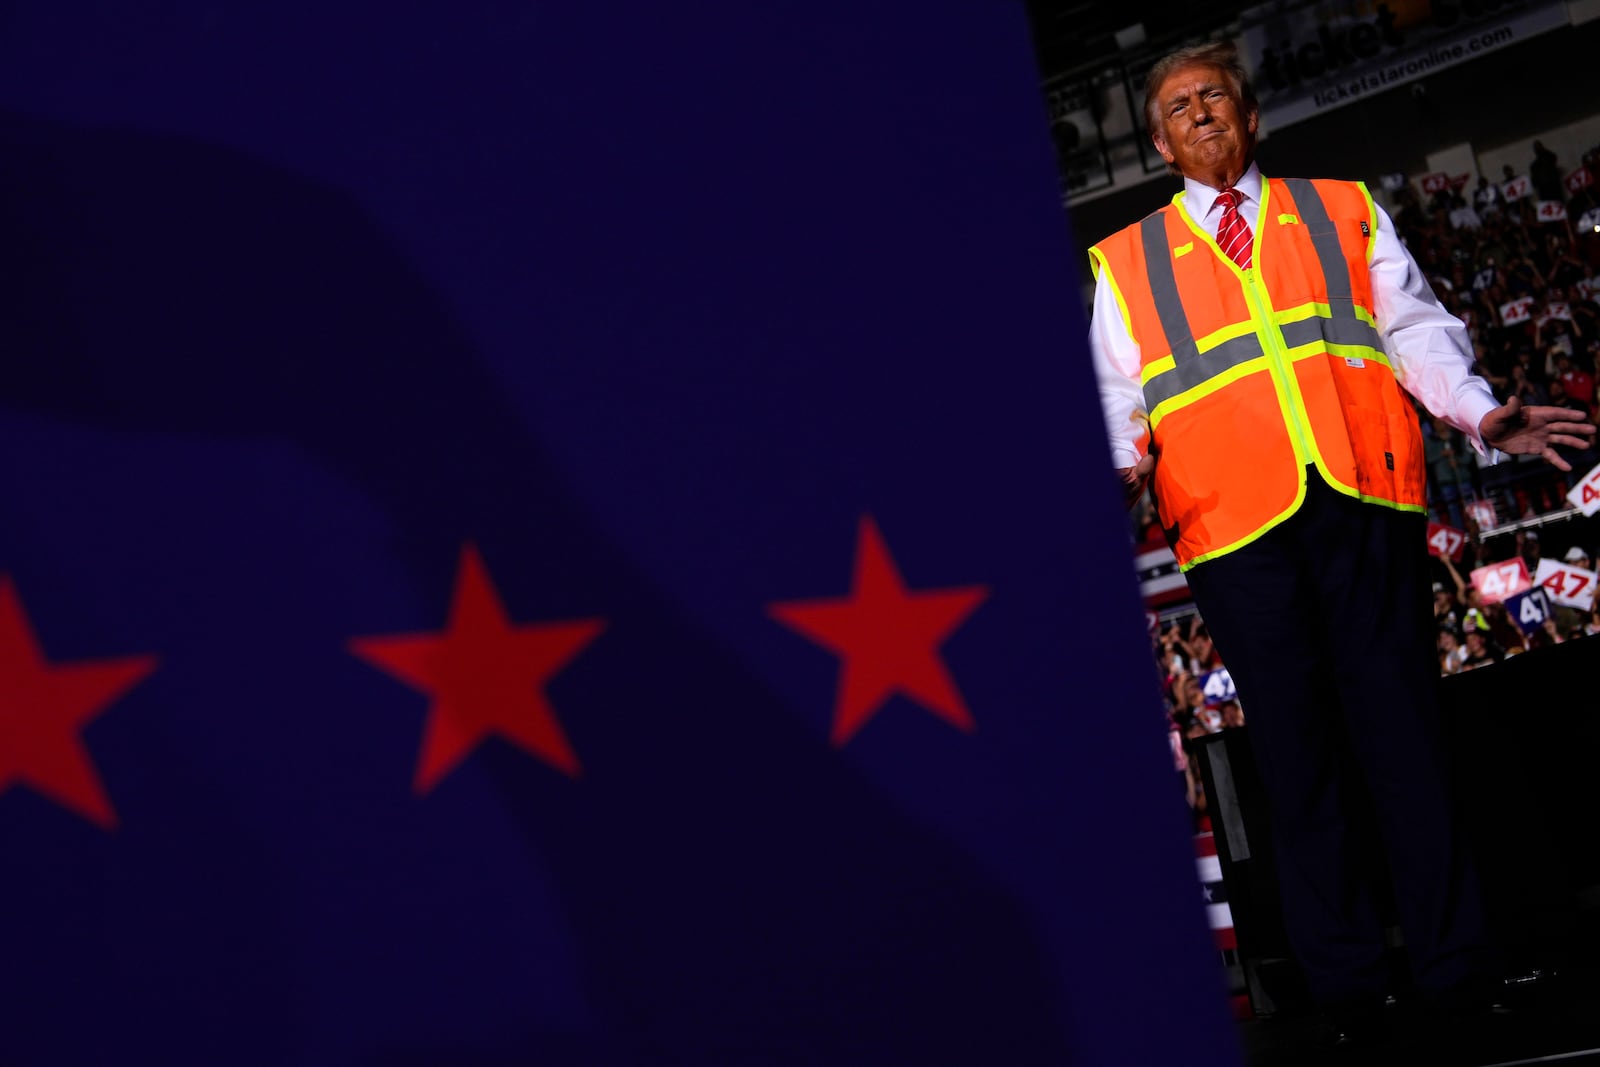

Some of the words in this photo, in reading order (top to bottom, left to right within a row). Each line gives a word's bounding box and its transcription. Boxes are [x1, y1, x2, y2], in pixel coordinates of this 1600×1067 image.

[1262, 4, 1404, 90] ticket
[1313, 24, 1513, 108] ticketstaronline.com
[1541, 202, 1563, 216] 47
[1472, 268, 1493, 290] 47
[1505, 303, 1531, 319] 47
[1429, 527, 1463, 555] 47
[1483, 563, 1521, 595] 47
[1542, 570, 1589, 598] 47
[1520, 591, 1549, 624] 47
